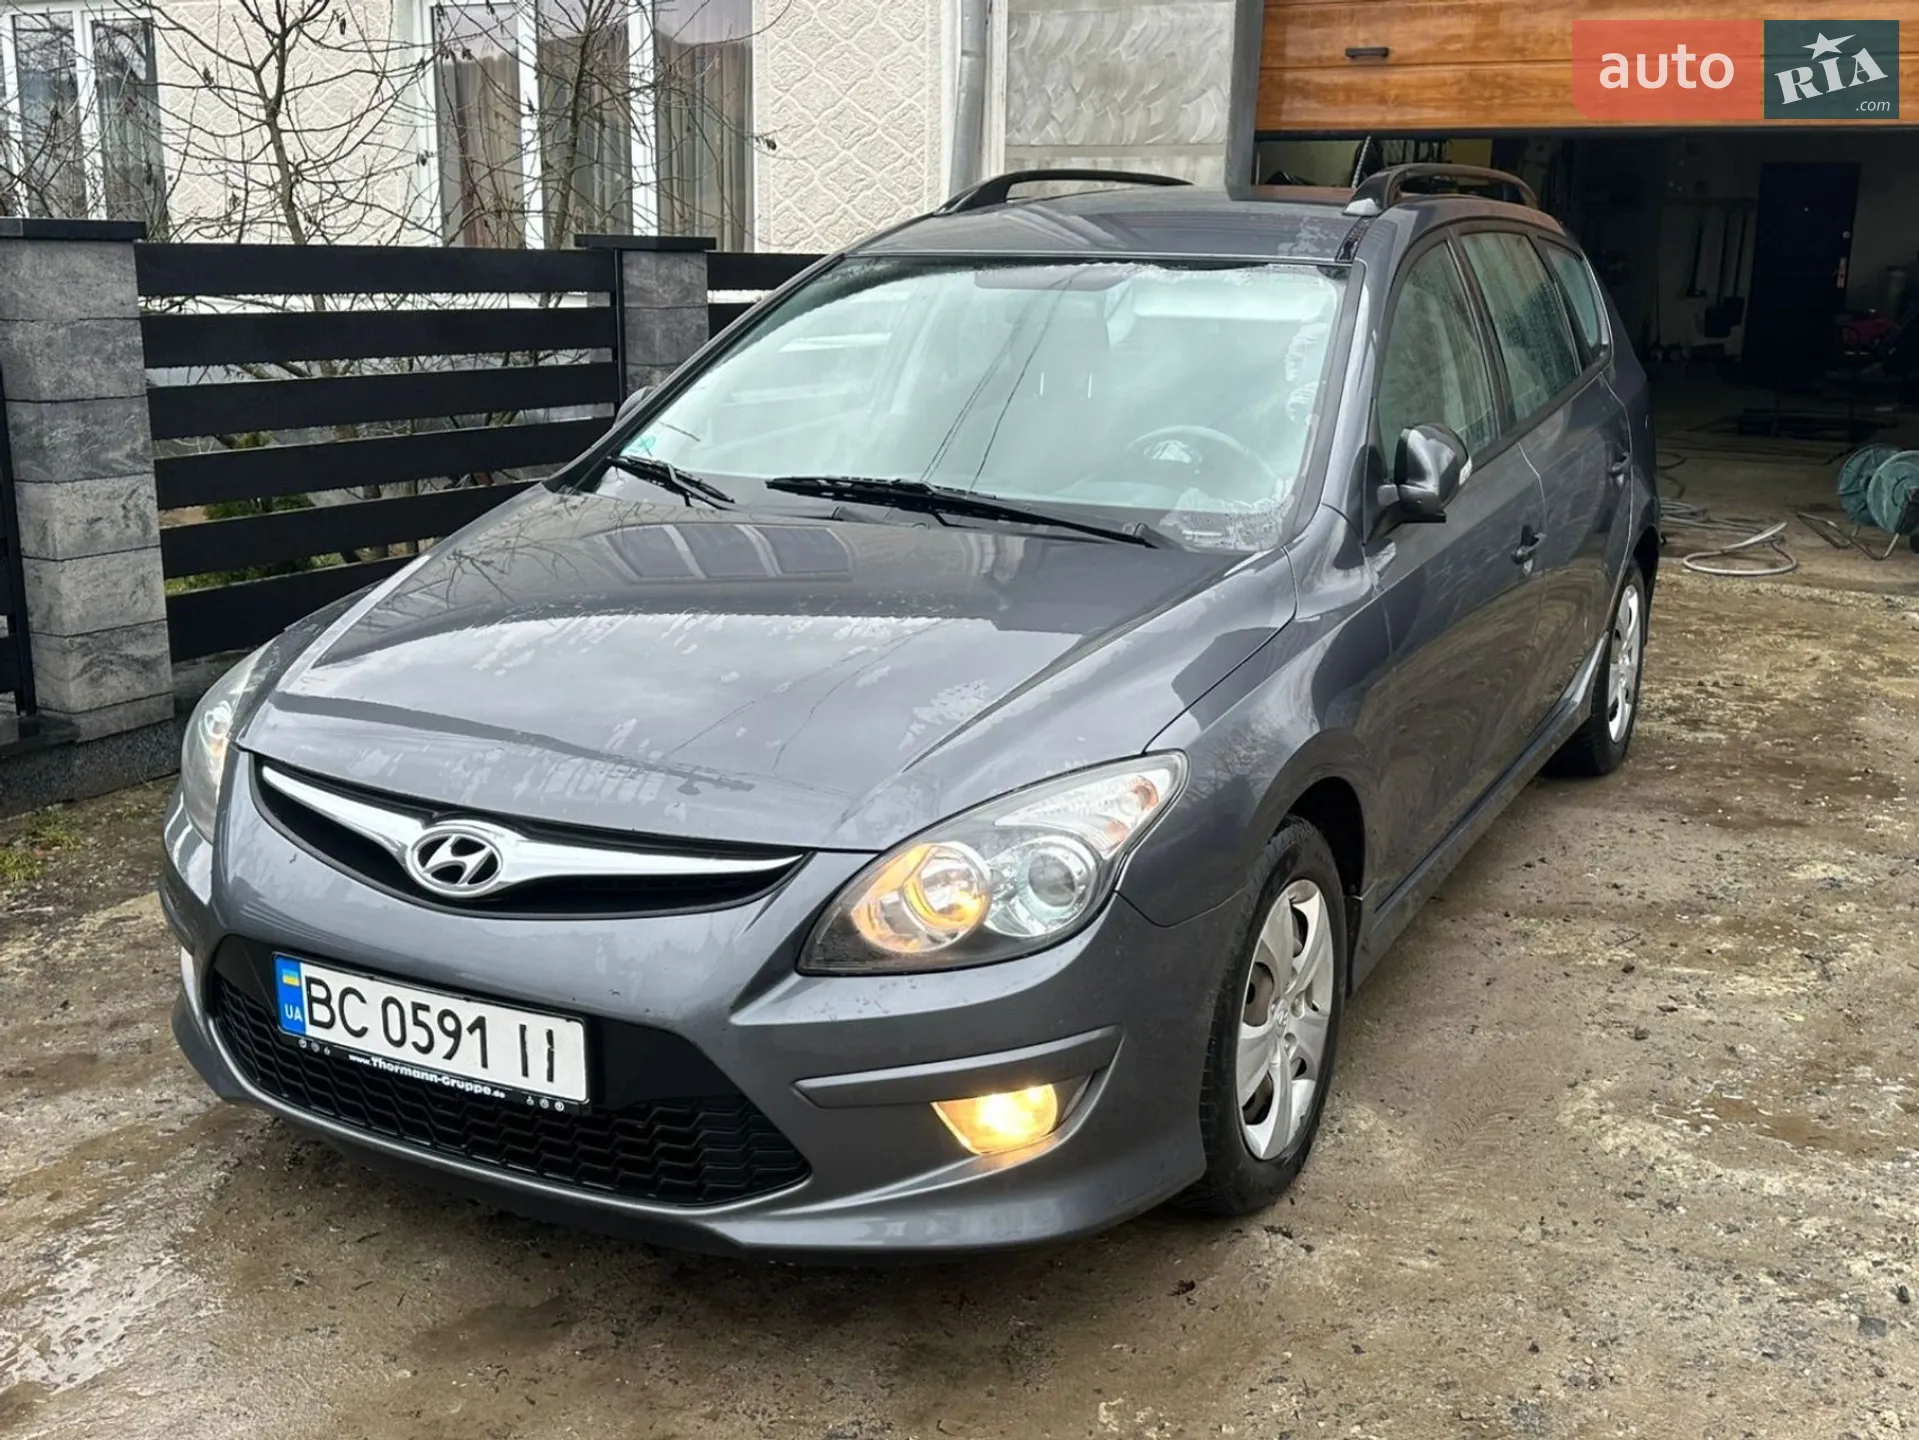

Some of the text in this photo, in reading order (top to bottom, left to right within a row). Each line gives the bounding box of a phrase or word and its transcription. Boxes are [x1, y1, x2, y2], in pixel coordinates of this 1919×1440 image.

[285, 1003, 304, 1023] UA
[304, 974, 369, 1039] BC
[381, 995, 489, 1070] 0591
[348, 1053, 506, 1099] www.Thormann-Gruppe.de
